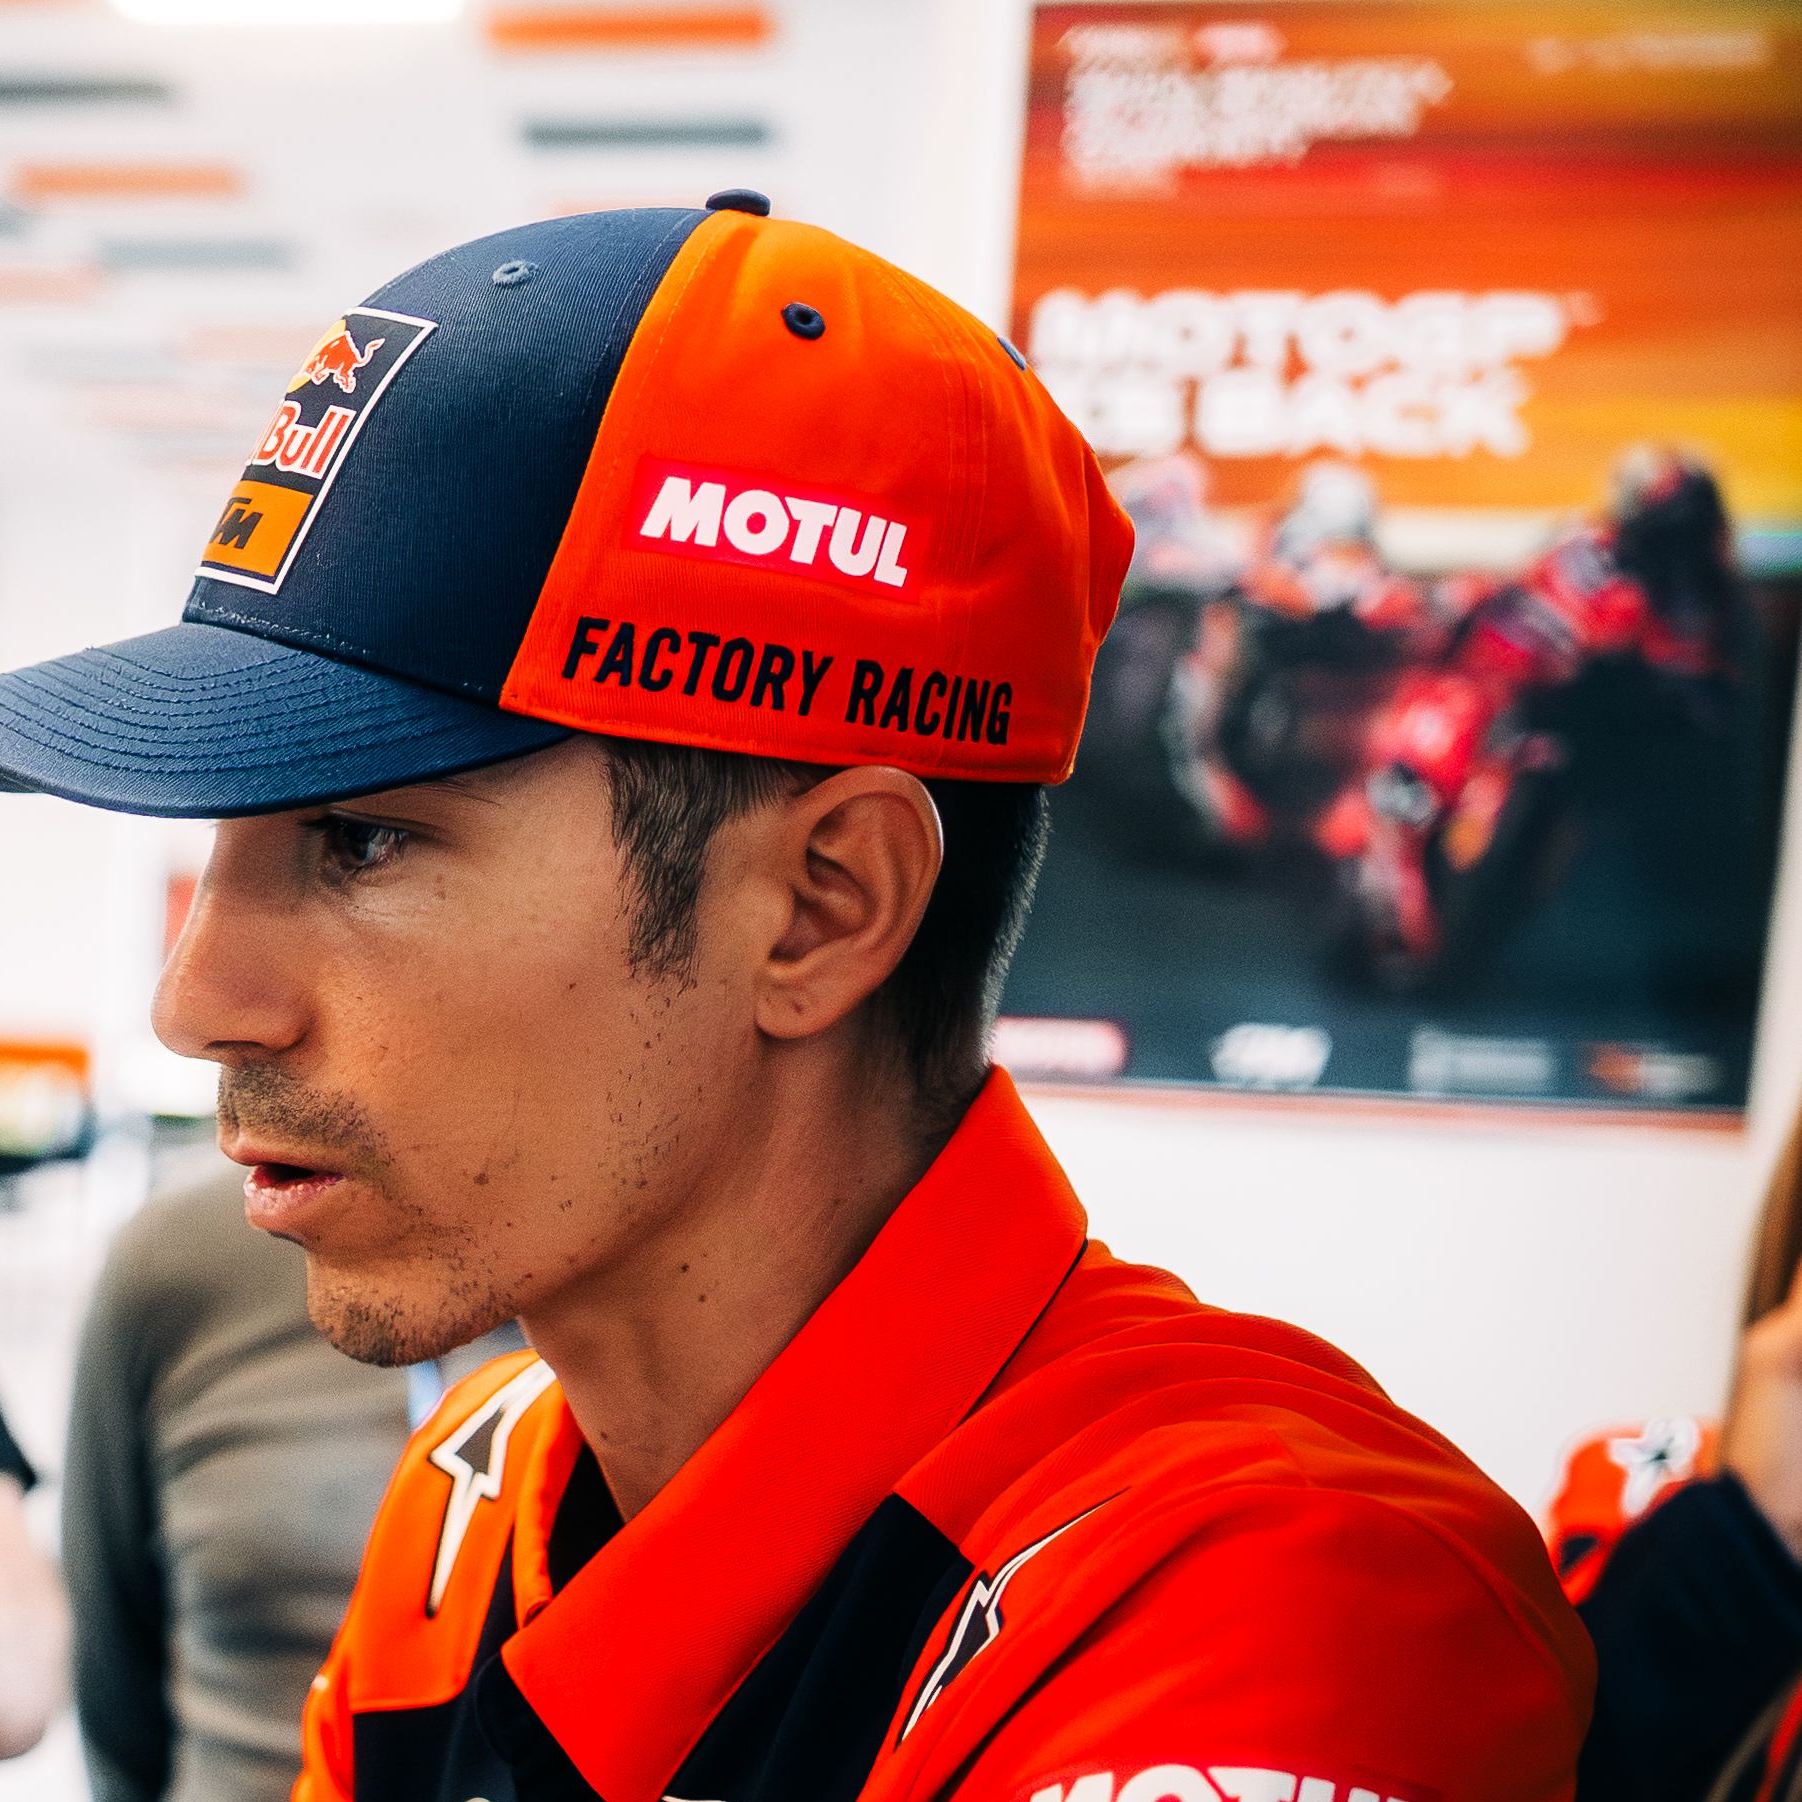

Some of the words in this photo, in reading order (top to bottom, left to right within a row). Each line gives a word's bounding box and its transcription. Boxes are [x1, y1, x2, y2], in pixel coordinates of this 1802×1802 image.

[209, 497, 264, 549] TM
[640, 476, 909, 588] MOTUL
[562, 617, 835, 718] FACTORY
[844, 659, 1012, 746] RACING
